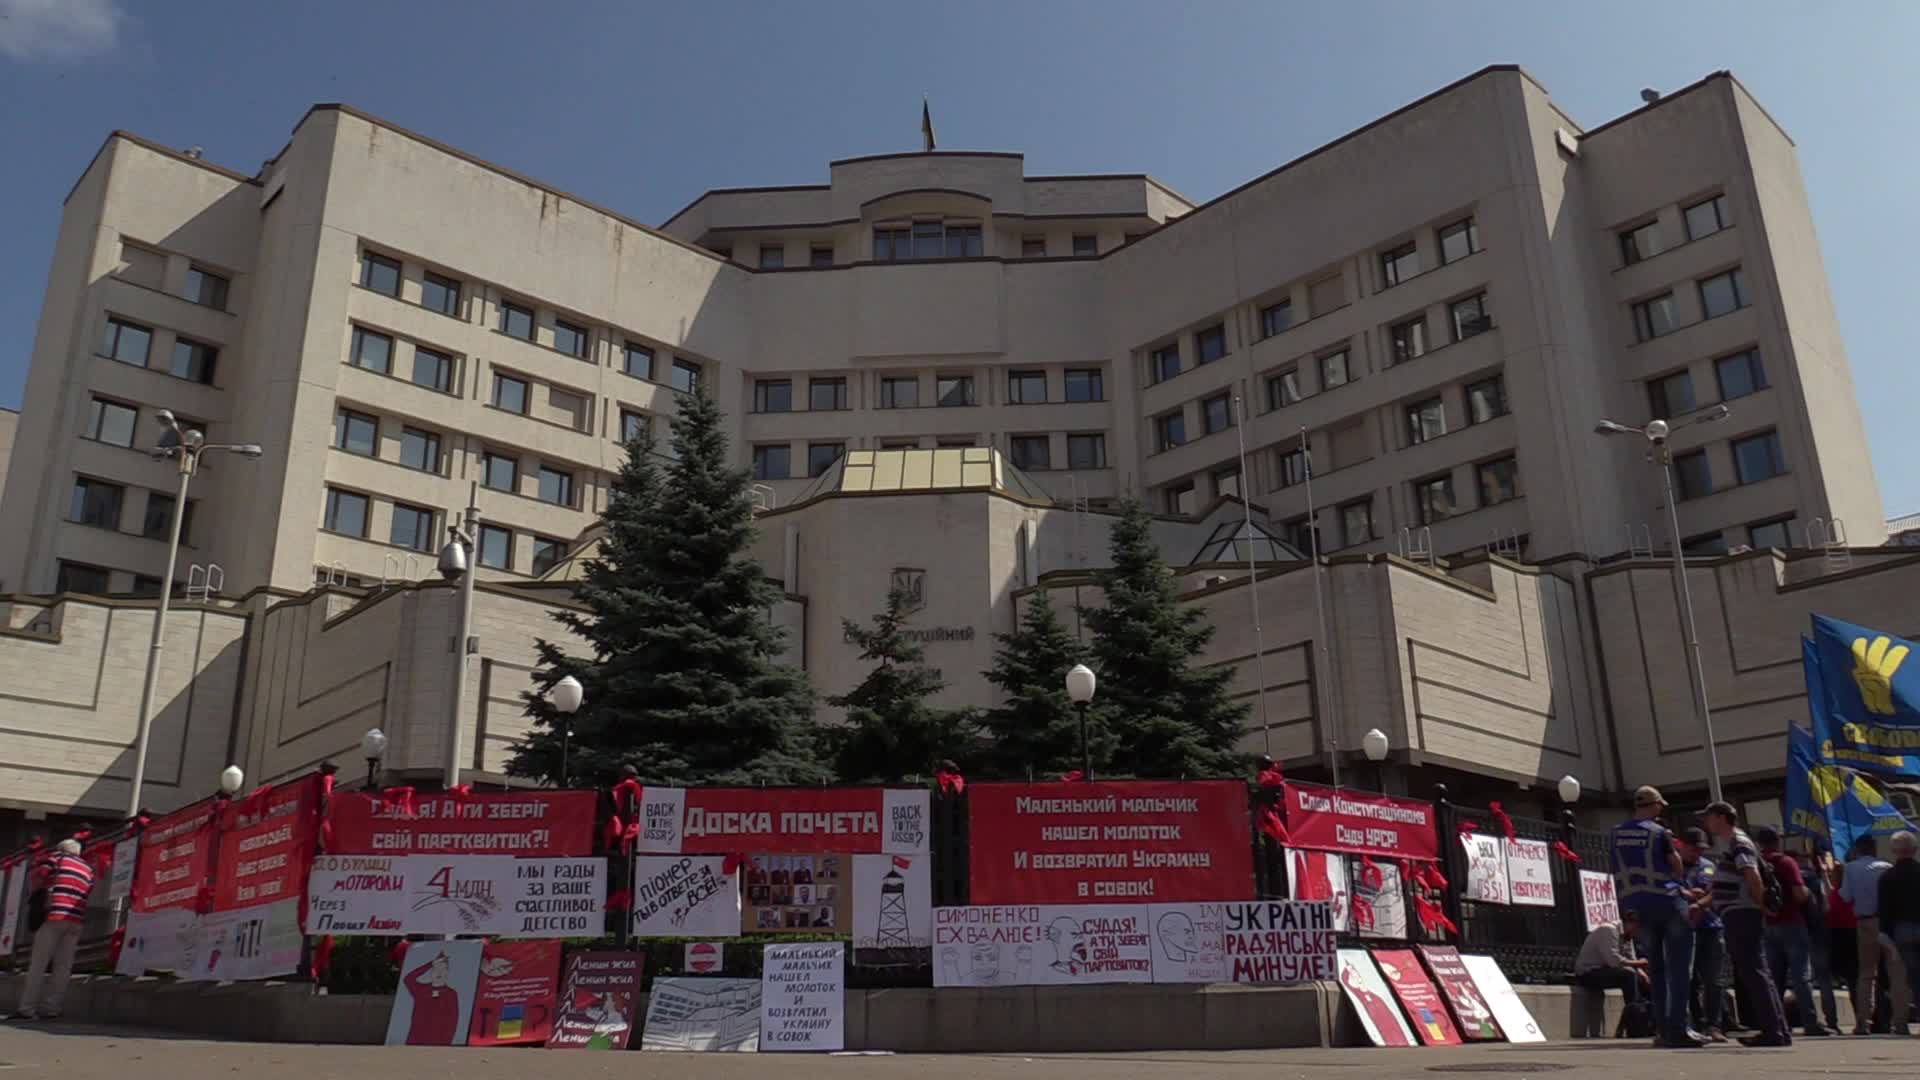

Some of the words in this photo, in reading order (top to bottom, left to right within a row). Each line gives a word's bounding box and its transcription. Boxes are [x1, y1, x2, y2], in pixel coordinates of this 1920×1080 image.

[487, 799, 550, 819] ЗБЕРІГ
[646, 803, 676, 817] BACK
[892, 804, 923, 820] BACK
[684, 807, 773, 838] ДОСКА
[780, 811, 879, 834] ПОЧЕТА
[372, 829, 412, 849] СВІЙ
[418, 829, 550, 849] ПАРТКВИТОК?!
[1014, 852, 1029, 869] И
[517, 865, 545, 879] МЫ
[936, 907, 1040, 924] СИМОНЕНКО
[936, 926, 1041, 944] СХВАЛЮЄ!
[1225, 931, 1336, 955] РАДЯНСЬКЕ
[1232, 956, 1336, 982] МИНУЛЕ!
[785, 983, 836, 993] МОЛОТОК
